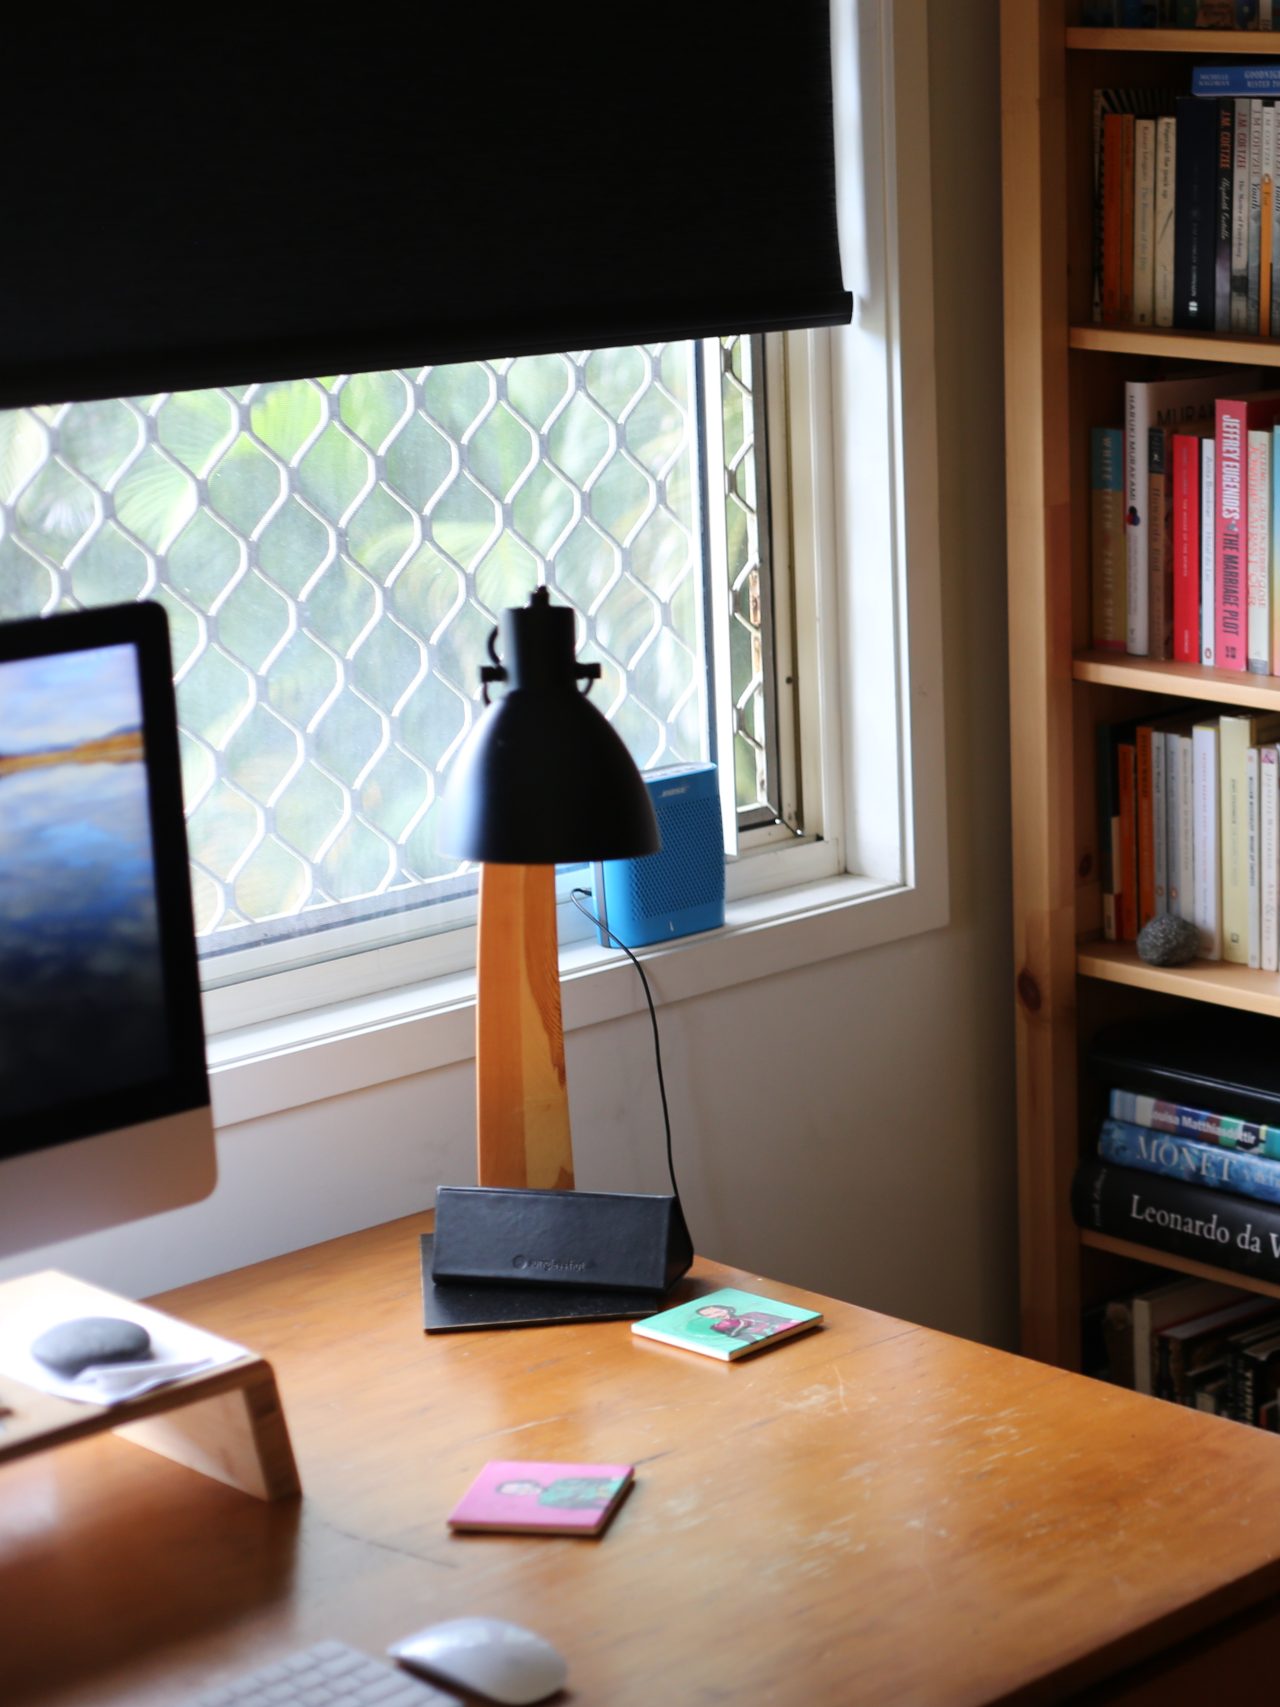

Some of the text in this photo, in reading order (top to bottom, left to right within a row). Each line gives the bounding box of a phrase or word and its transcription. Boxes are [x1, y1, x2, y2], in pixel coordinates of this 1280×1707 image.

[1222, 415, 1239, 636] JEFFREY EUGENIDES THE MARRIAGE PLOT
[1136, 1135, 1240, 1181] MONET
[1130, 1194, 1230, 1244] Leonardo
[1236, 1224, 1262, 1254] da
